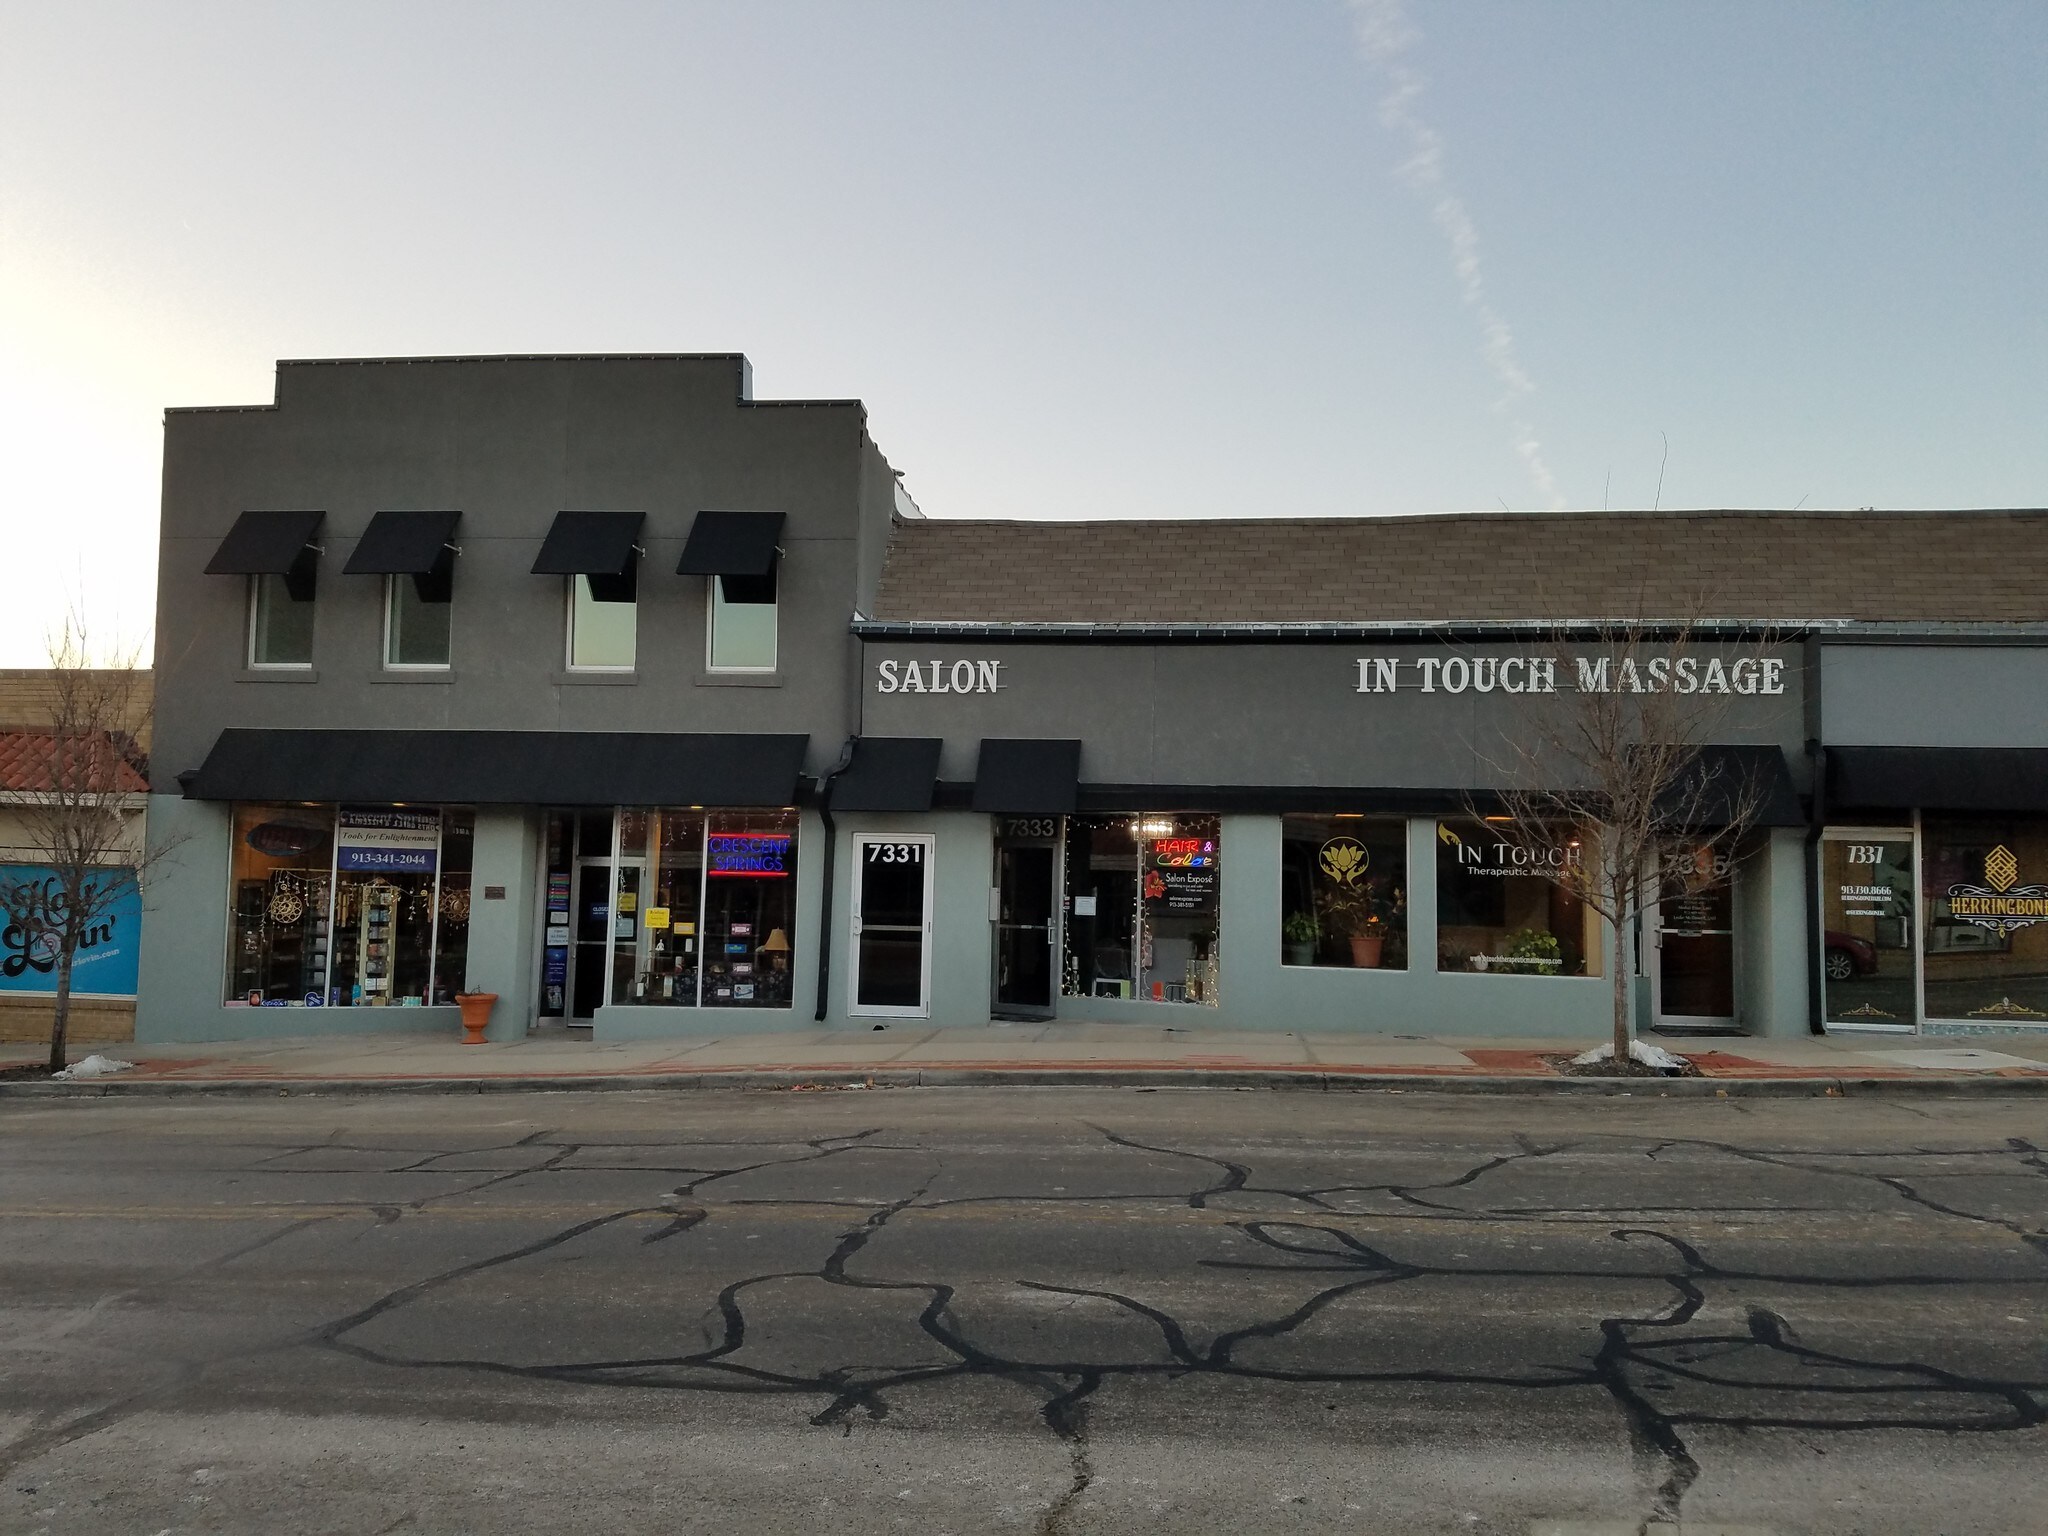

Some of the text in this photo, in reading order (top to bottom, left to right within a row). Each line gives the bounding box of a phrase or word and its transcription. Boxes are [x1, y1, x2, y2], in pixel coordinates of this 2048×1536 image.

[878, 660, 1000, 694] SALON
[1357, 657, 1784, 694] IN TOUCH MASSAGE
[1008, 819, 1054, 837] 7333
[364, 832, 378, 841] for
[379, 834, 437, 842] Enlightenment
[710, 838, 790, 854] CRESCENT
[868, 844, 921, 863] 7331
[1156, 840, 1212, 852] HAIR &
[352, 853, 426, 864] 913-341-2044
[1458, 843, 1581, 866] IN TOUCH
[1848, 846, 1884, 864] 7337
[716, 855, 783, 871] SPRINGS
[1166, 872, 1213, 885] Salon Exposé
[1467, 866, 1528, 878] Therapeutic
[1841, 886, 1892, 895] 913.730.8666
